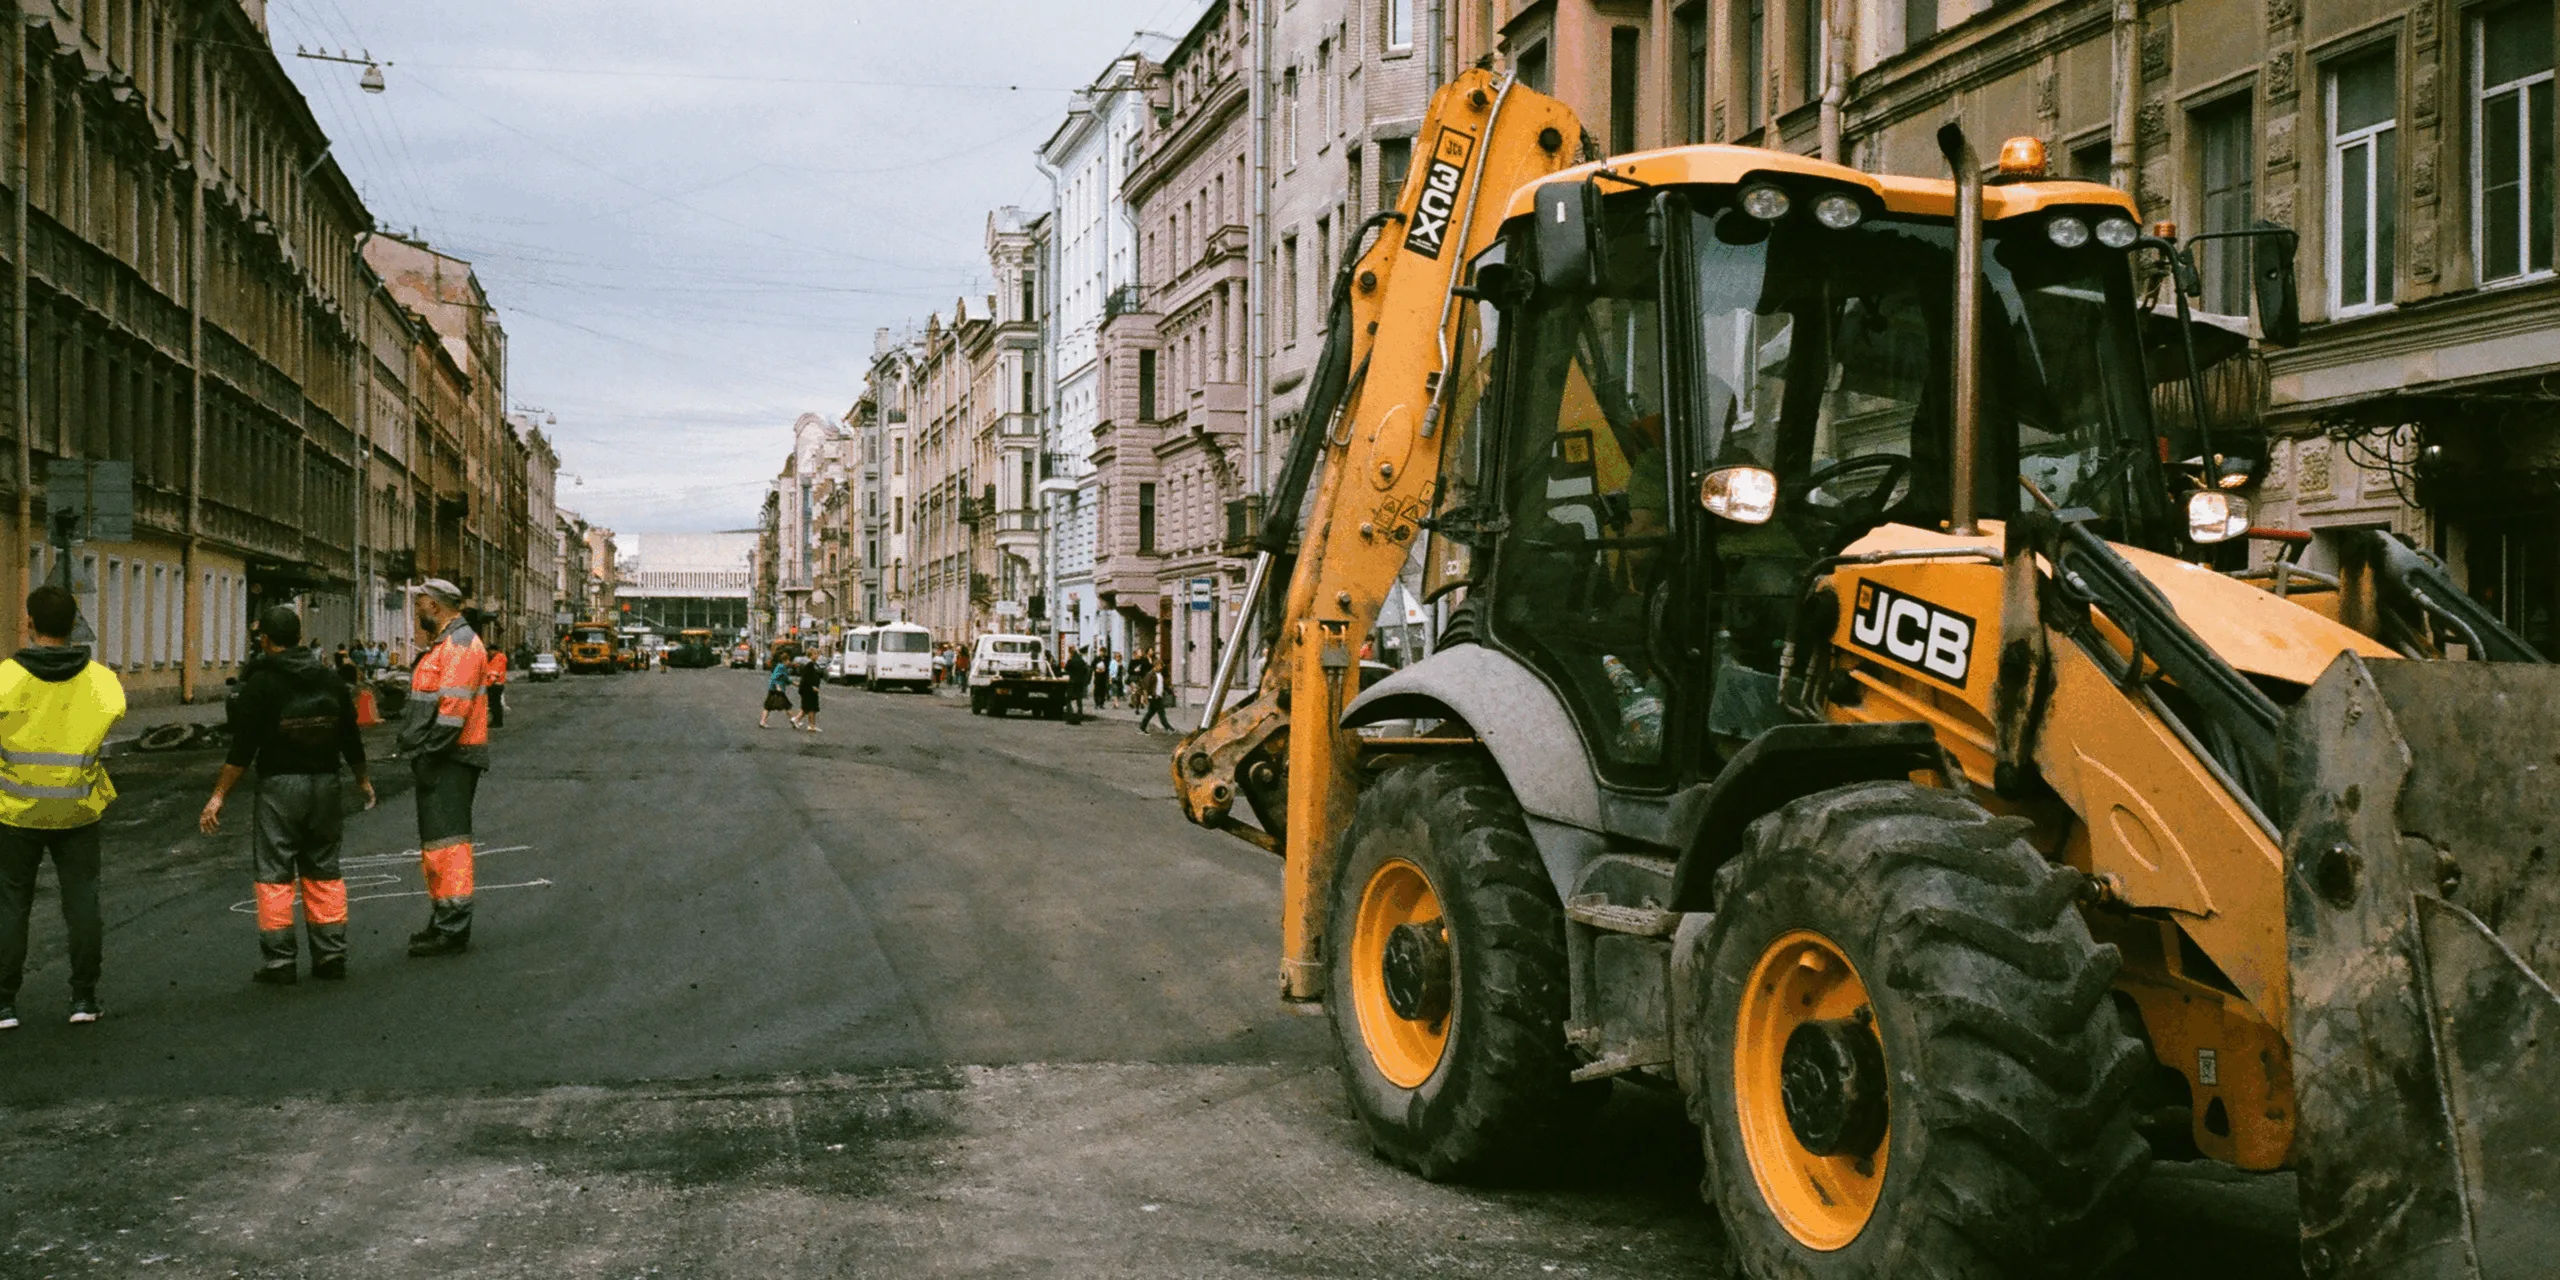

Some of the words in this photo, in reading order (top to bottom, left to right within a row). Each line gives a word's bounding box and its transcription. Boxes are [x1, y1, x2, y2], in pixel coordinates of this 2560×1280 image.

[1446, 140, 1463, 156] JCB
[1410, 163, 1459, 245] 3CX
[1855, 591, 1970, 679] JCB
